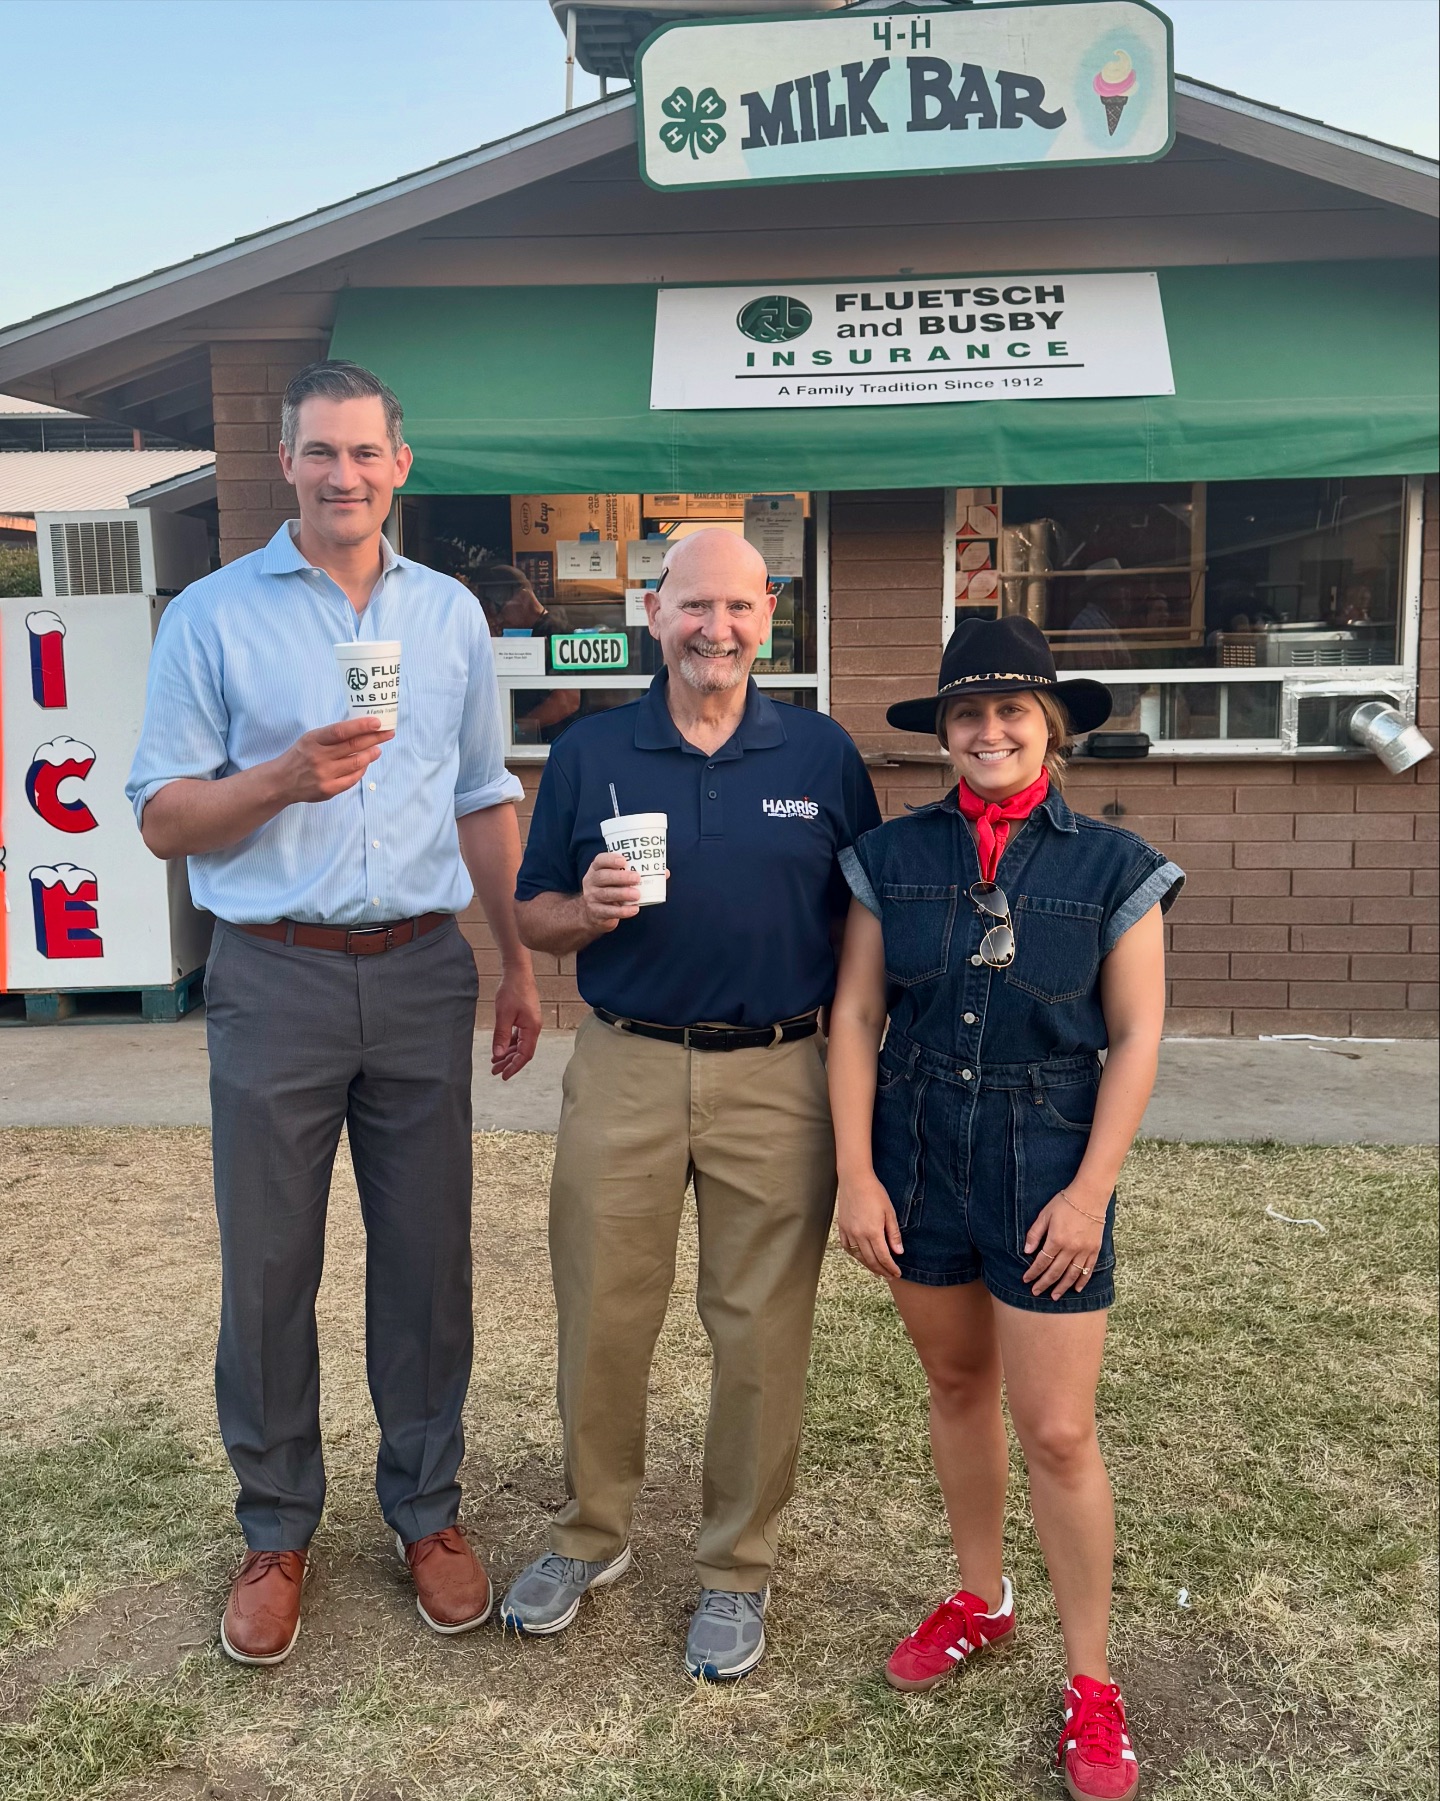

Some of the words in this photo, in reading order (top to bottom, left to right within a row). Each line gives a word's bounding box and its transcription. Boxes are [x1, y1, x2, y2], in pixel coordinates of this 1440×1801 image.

[873, 19, 931, 51] 4-H
[740, 56, 891, 150] MILK
[906, 56, 1067, 132] BAR
[835, 284, 1066, 312] FLUETSCH
[836, 317, 903, 339] and
[919, 311, 1065, 336] BUSBY
[746, 341, 1069, 367] INSURANCE
[777, 386, 791, 396] A
[796, 383, 854, 396] Family
[859, 380, 939, 394] Tradition
[944, 378, 995, 391] Since
[1001, 377, 1044, 389] 1912
[559, 638, 621, 664] CLOSED
[372, 678, 394, 689] and
[350, 691, 399, 703] INSUR
[607, 835, 666, 853] LUETSCH
